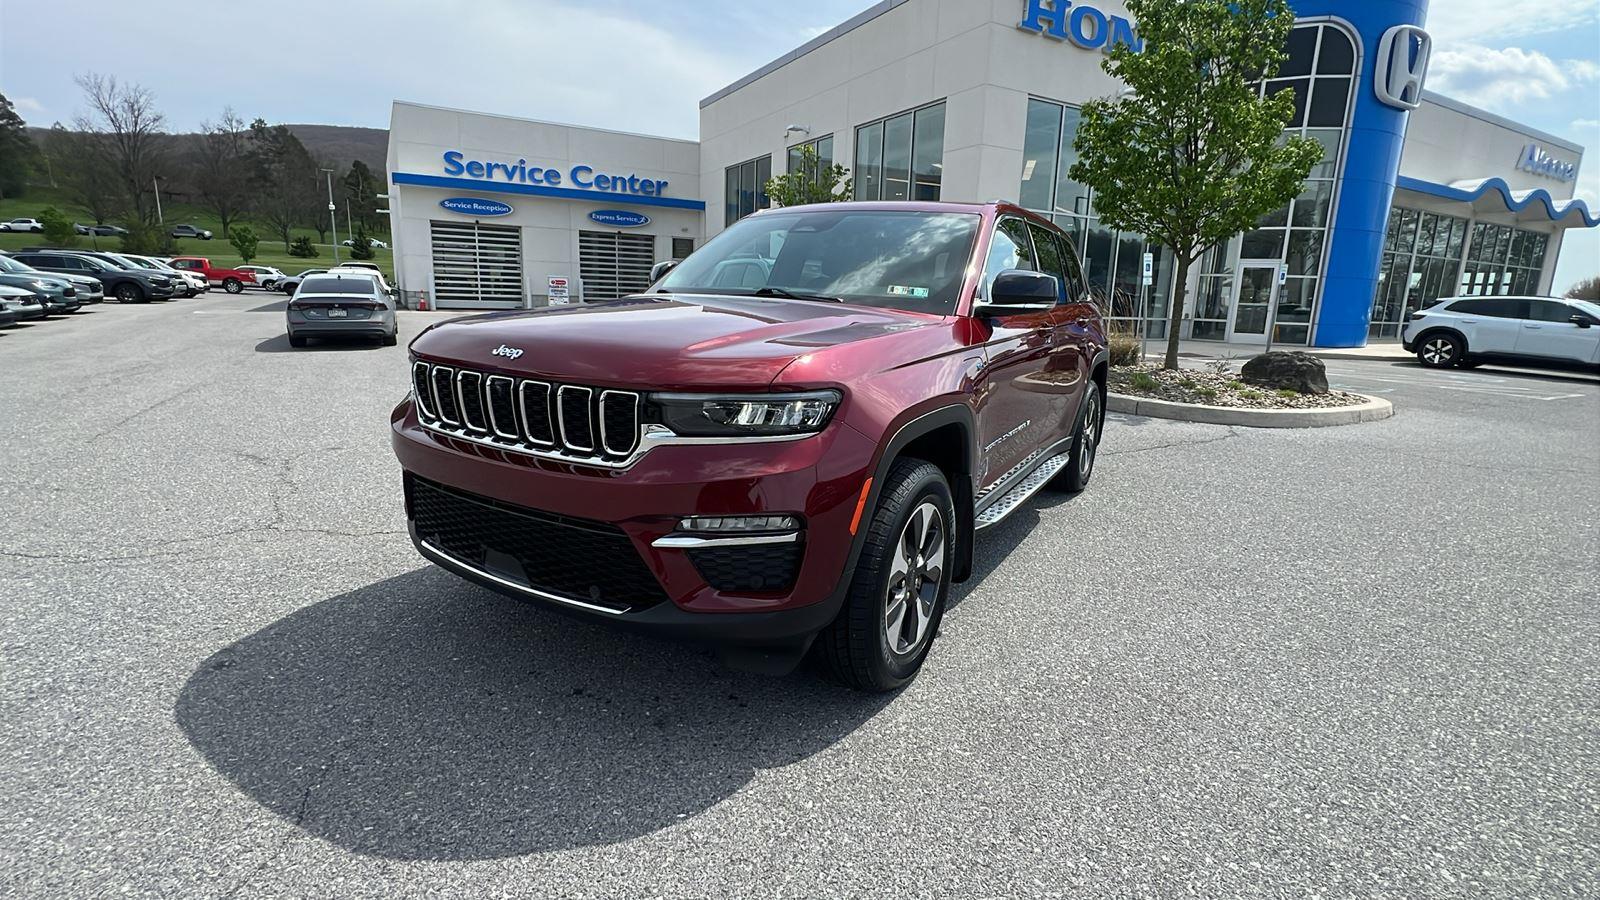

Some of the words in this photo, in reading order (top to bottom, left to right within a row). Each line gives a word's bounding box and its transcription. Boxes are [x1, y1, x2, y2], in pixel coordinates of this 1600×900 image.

[1019, 0, 1144, 54] HON
[443, 150, 562, 186] Service
[570, 165, 669, 196] Center
[443, 200, 472, 209] Service
[473, 202, 509, 213] Reception
[592, 213, 615, 221] Express
[616, 214, 638, 223] Service
[491, 344, 524, 360] Jeep
